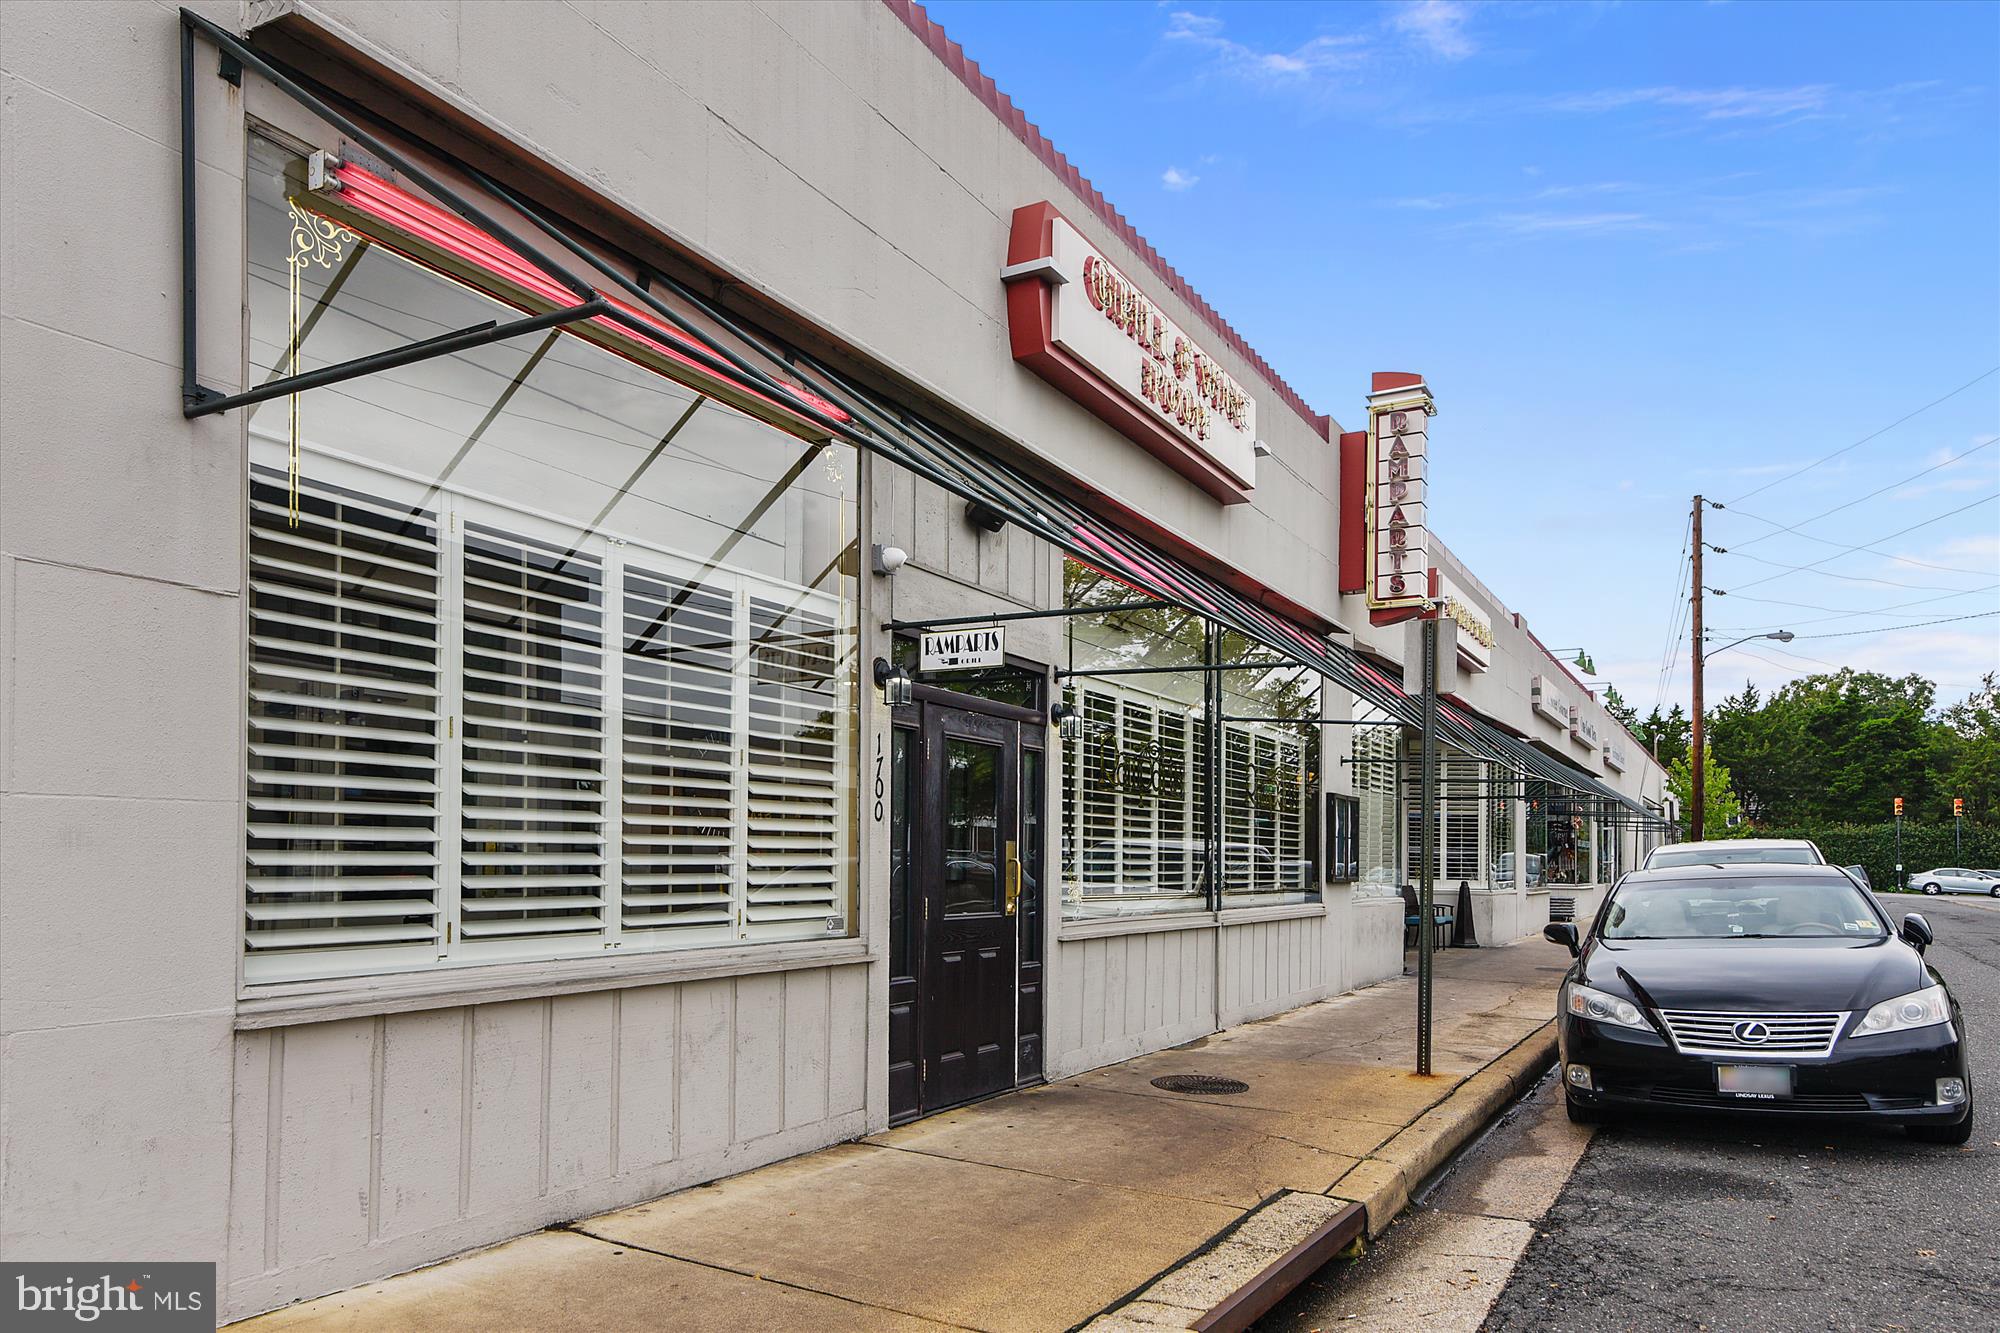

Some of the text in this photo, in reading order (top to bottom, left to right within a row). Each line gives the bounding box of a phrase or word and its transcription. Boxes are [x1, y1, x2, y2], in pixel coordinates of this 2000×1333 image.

[1083, 255, 1173, 367] GRILL
[1141, 356, 1211, 441] ROOM
[1388, 411, 1410, 595] RAMPARTS
[925, 631, 999, 656] RAMPARTS
[874, 733, 884, 822] 1700
